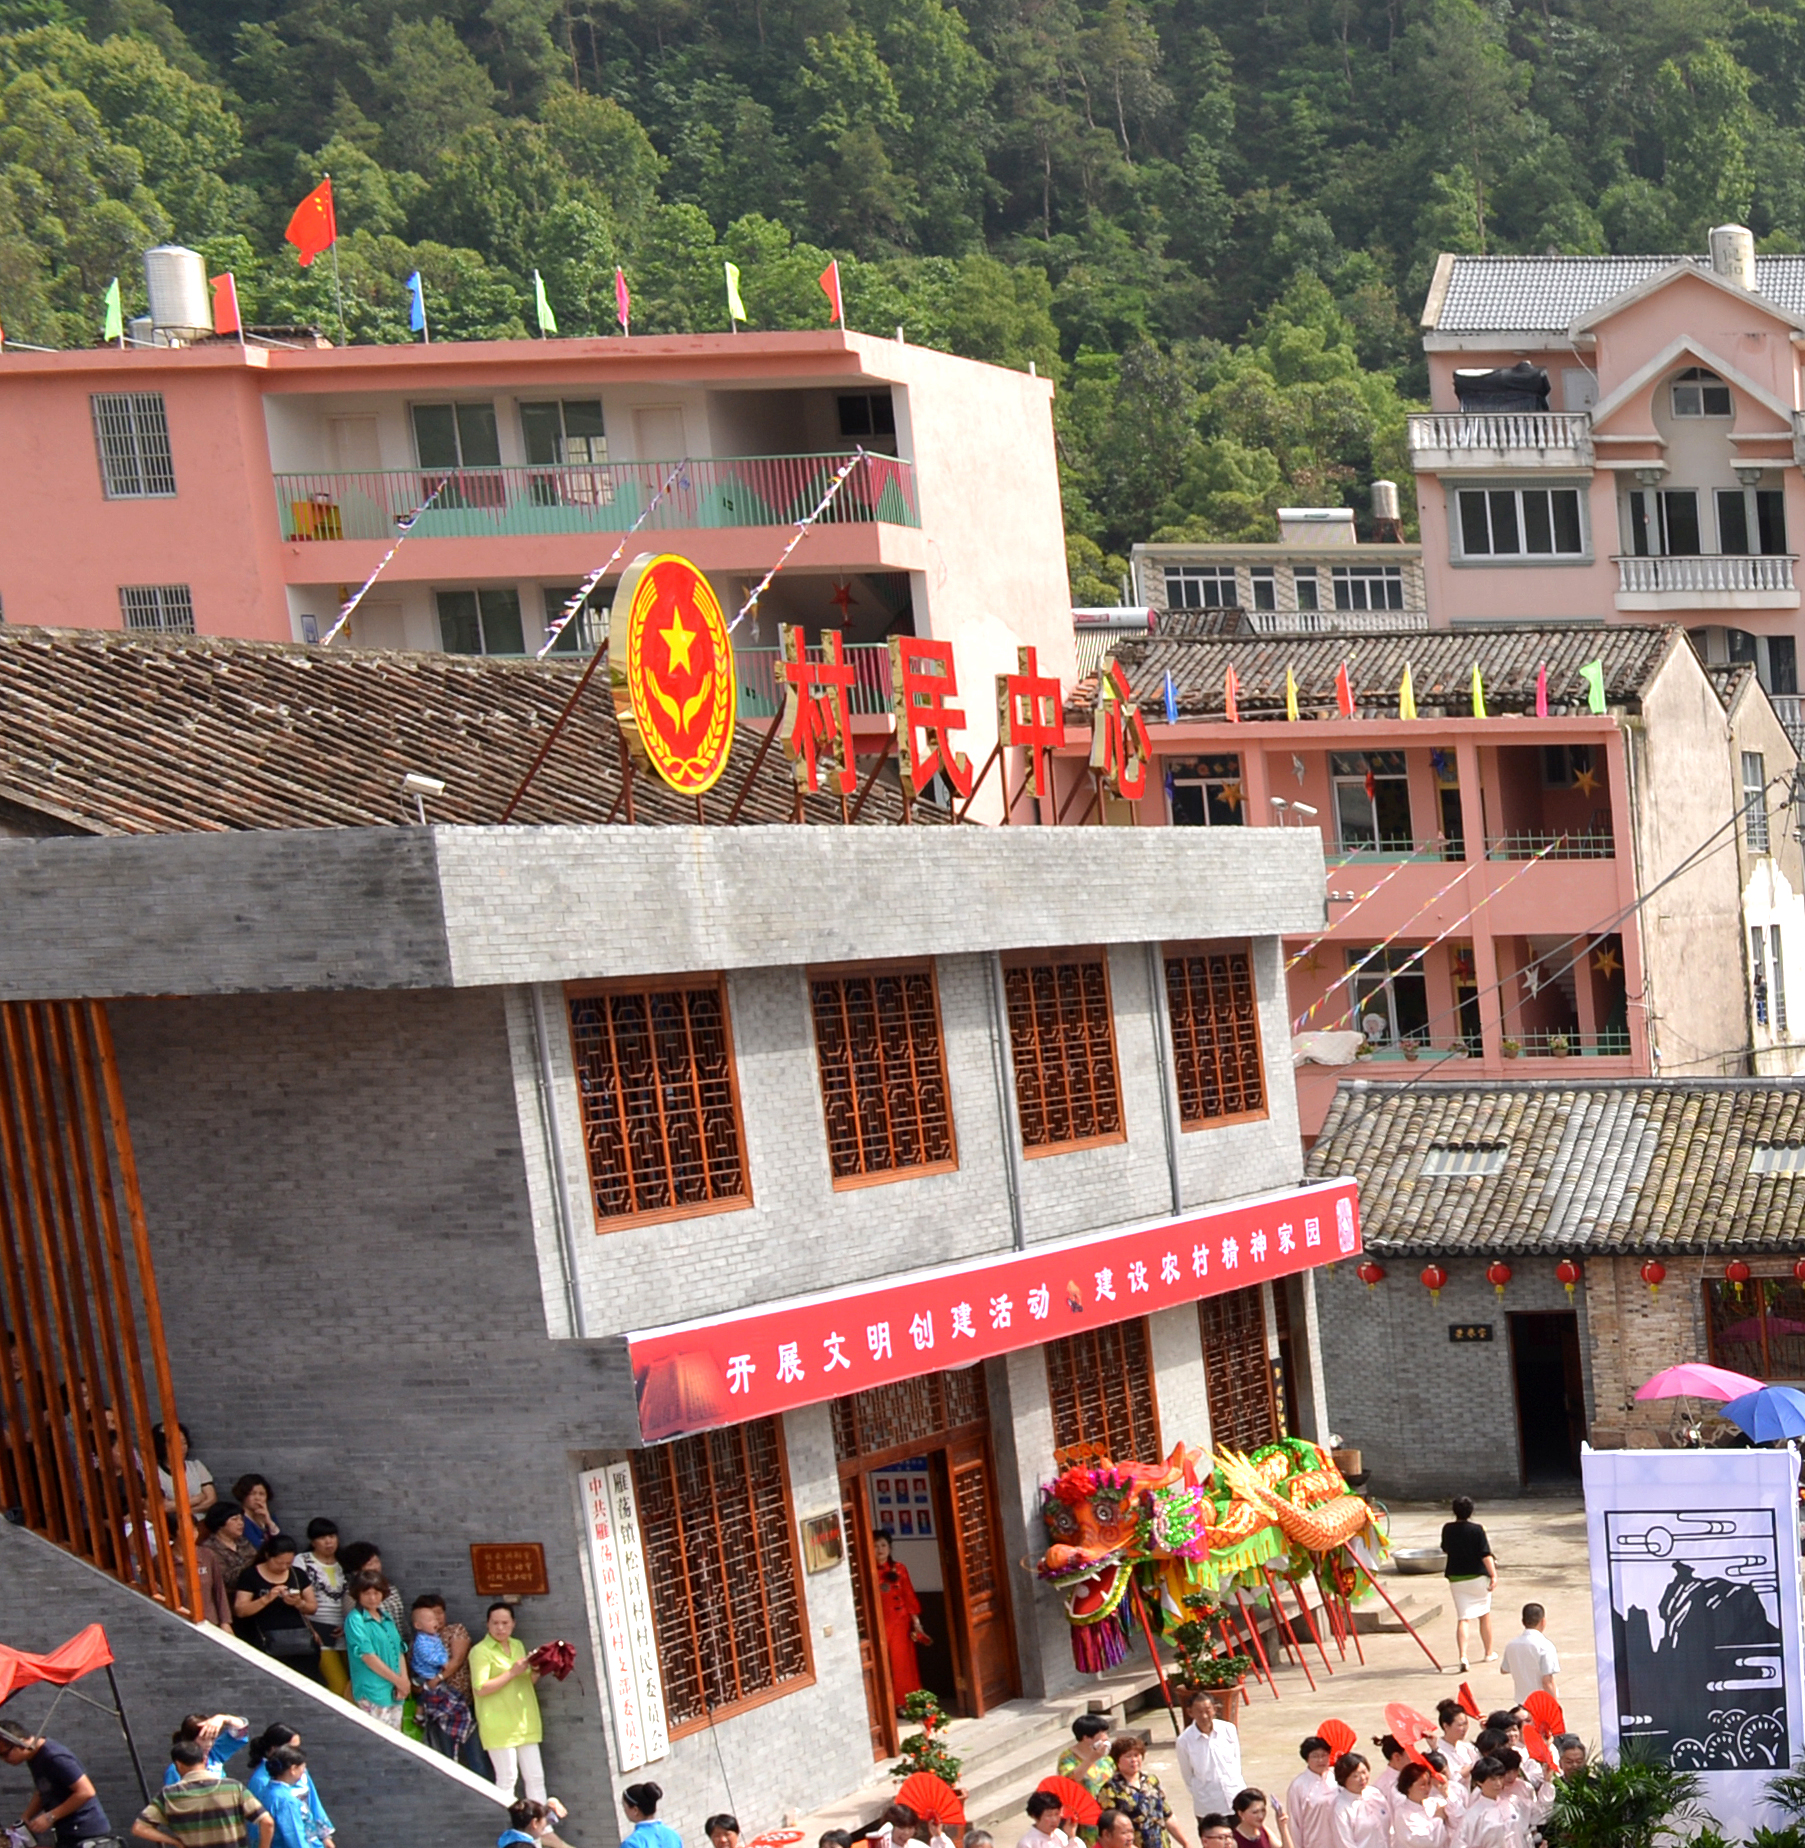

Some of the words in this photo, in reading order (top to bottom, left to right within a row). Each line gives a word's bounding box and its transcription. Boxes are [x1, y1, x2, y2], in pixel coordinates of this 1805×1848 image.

[775, 622, 1153, 800] 村民中心
[726, 1282, 1050, 1394] 开展文明创建活动
[1094, 1216, 1322, 1303] 建设农村精神家园
